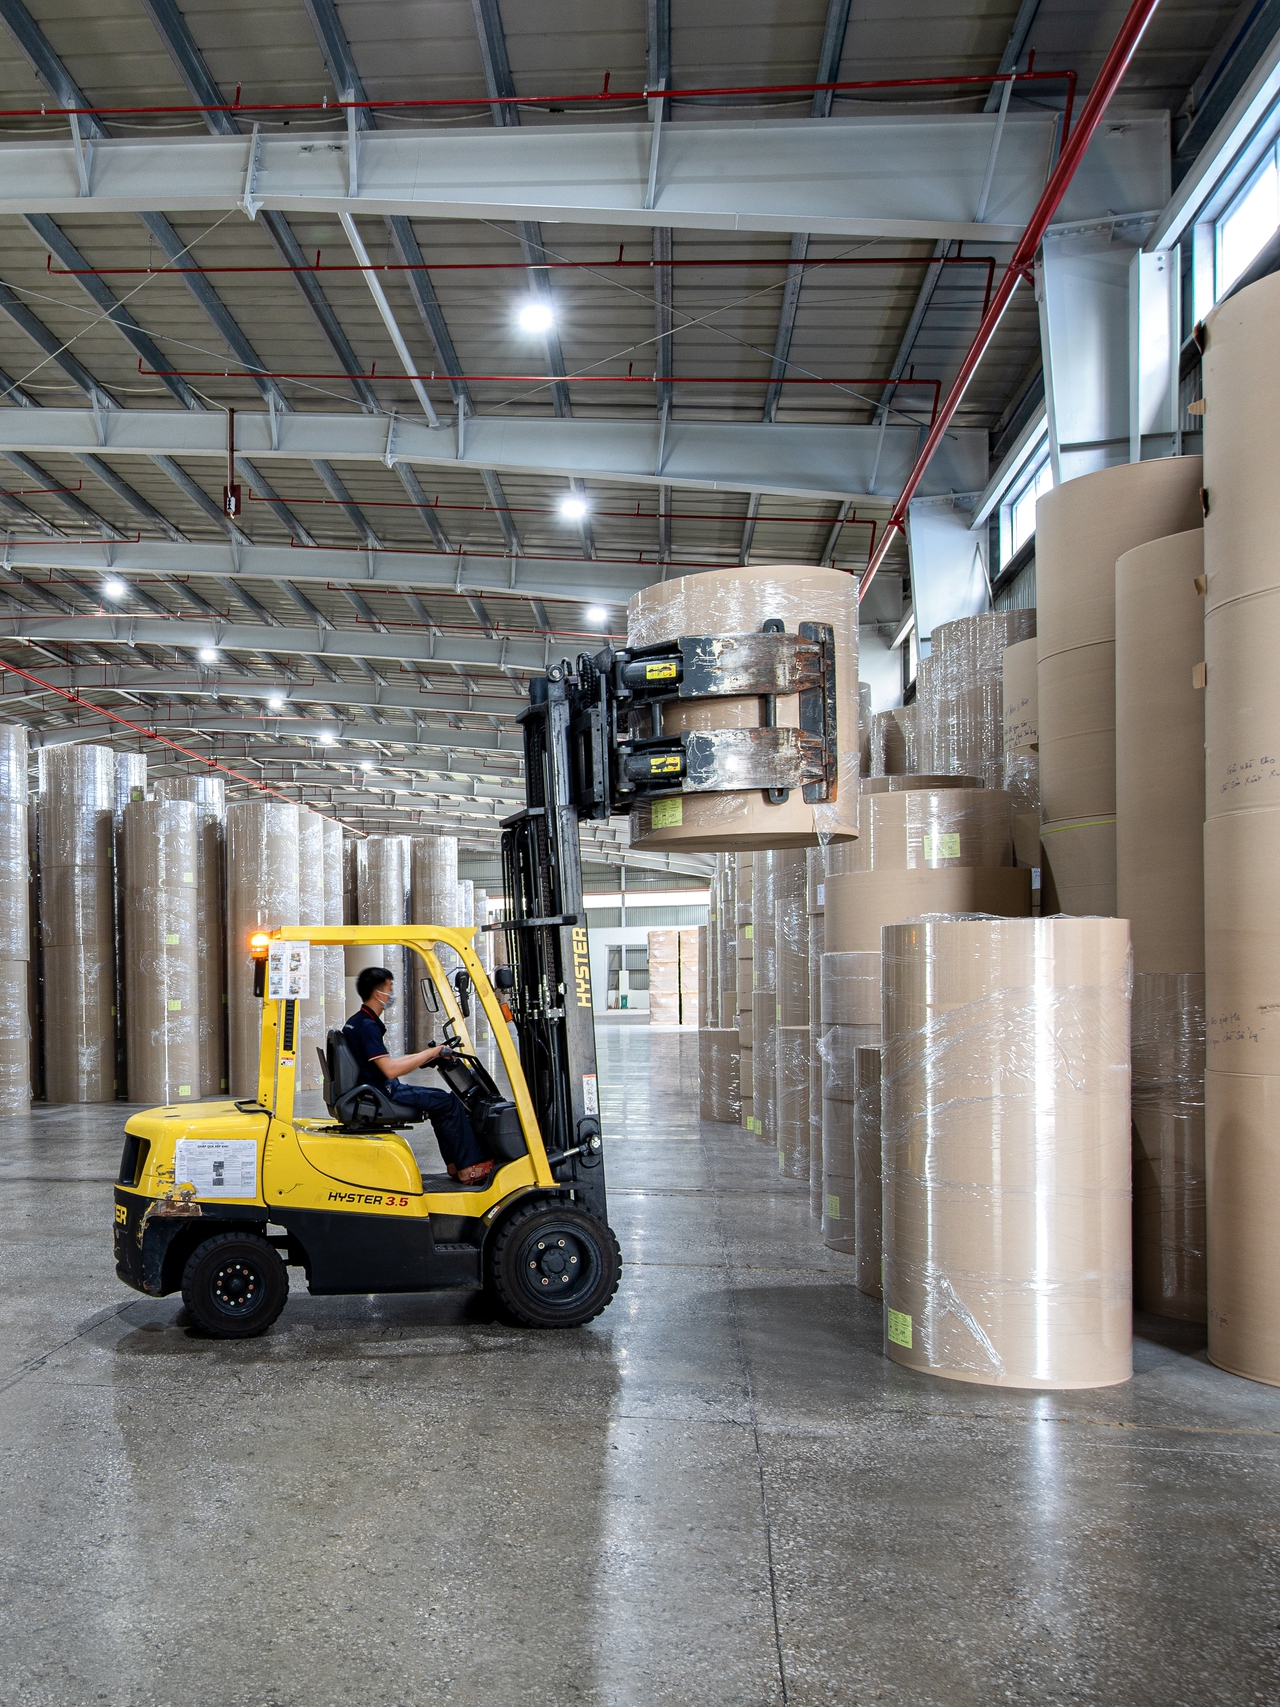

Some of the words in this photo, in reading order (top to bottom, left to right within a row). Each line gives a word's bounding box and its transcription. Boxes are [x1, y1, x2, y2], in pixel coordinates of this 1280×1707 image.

[571, 927, 592, 1007] HYSTER
[328, 1191, 383, 1205] HYSTER
[385, 1196, 409, 1207] 3.5
[114, 1203, 128, 1225] ER
